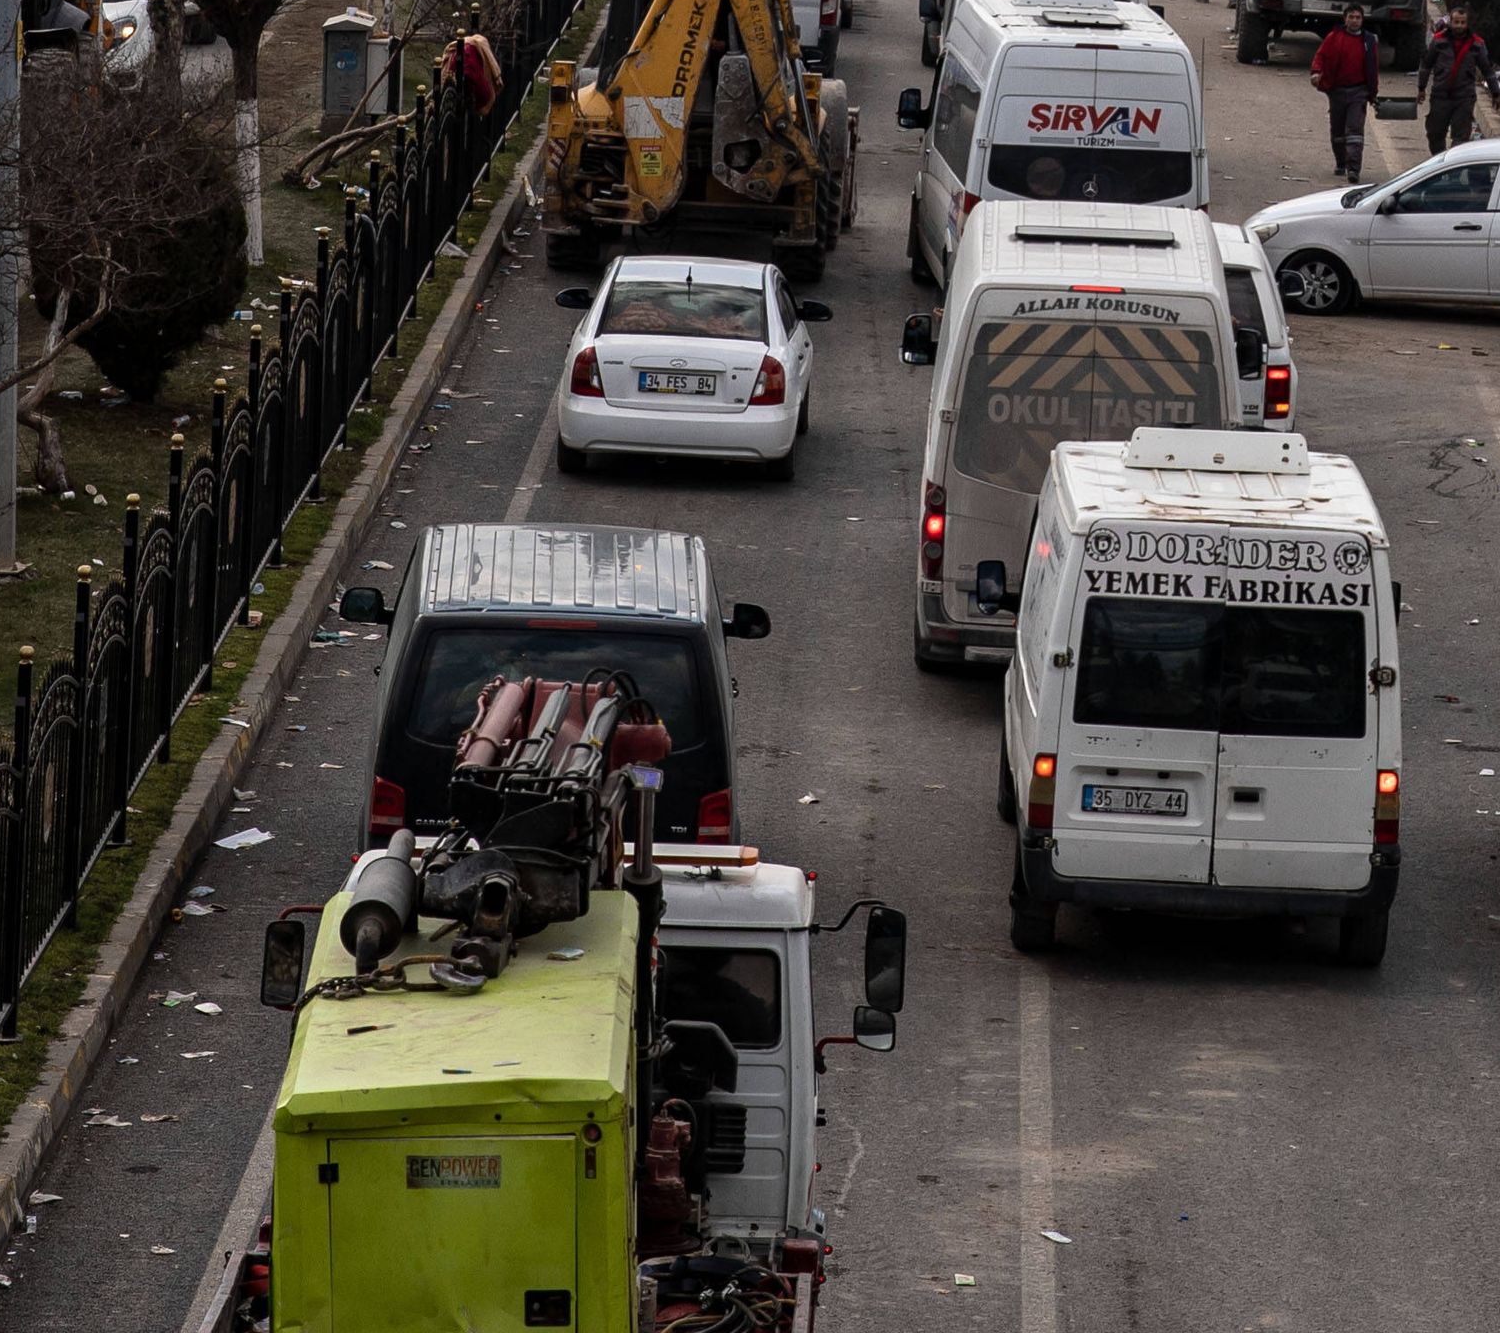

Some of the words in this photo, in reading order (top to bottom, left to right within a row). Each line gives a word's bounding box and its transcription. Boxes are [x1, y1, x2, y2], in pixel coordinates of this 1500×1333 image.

[1027, 103, 1162, 135] ŞİRVAN
[1077, 137, 1116, 147] TURİZM
[1013, 297, 1080, 316] ALLAH
[1085, 297, 1181, 324] KORUSUN
[988, 394, 1079, 424] OKUL
[1084, 569, 1194, 597] YEMEK
[1203, 574, 1371, 607] FABRİKASI
[1094, 790, 1112, 806] 35
[1125, 791, 1152, 808] DYZ
[1165, 794, 1182, 810] 44
